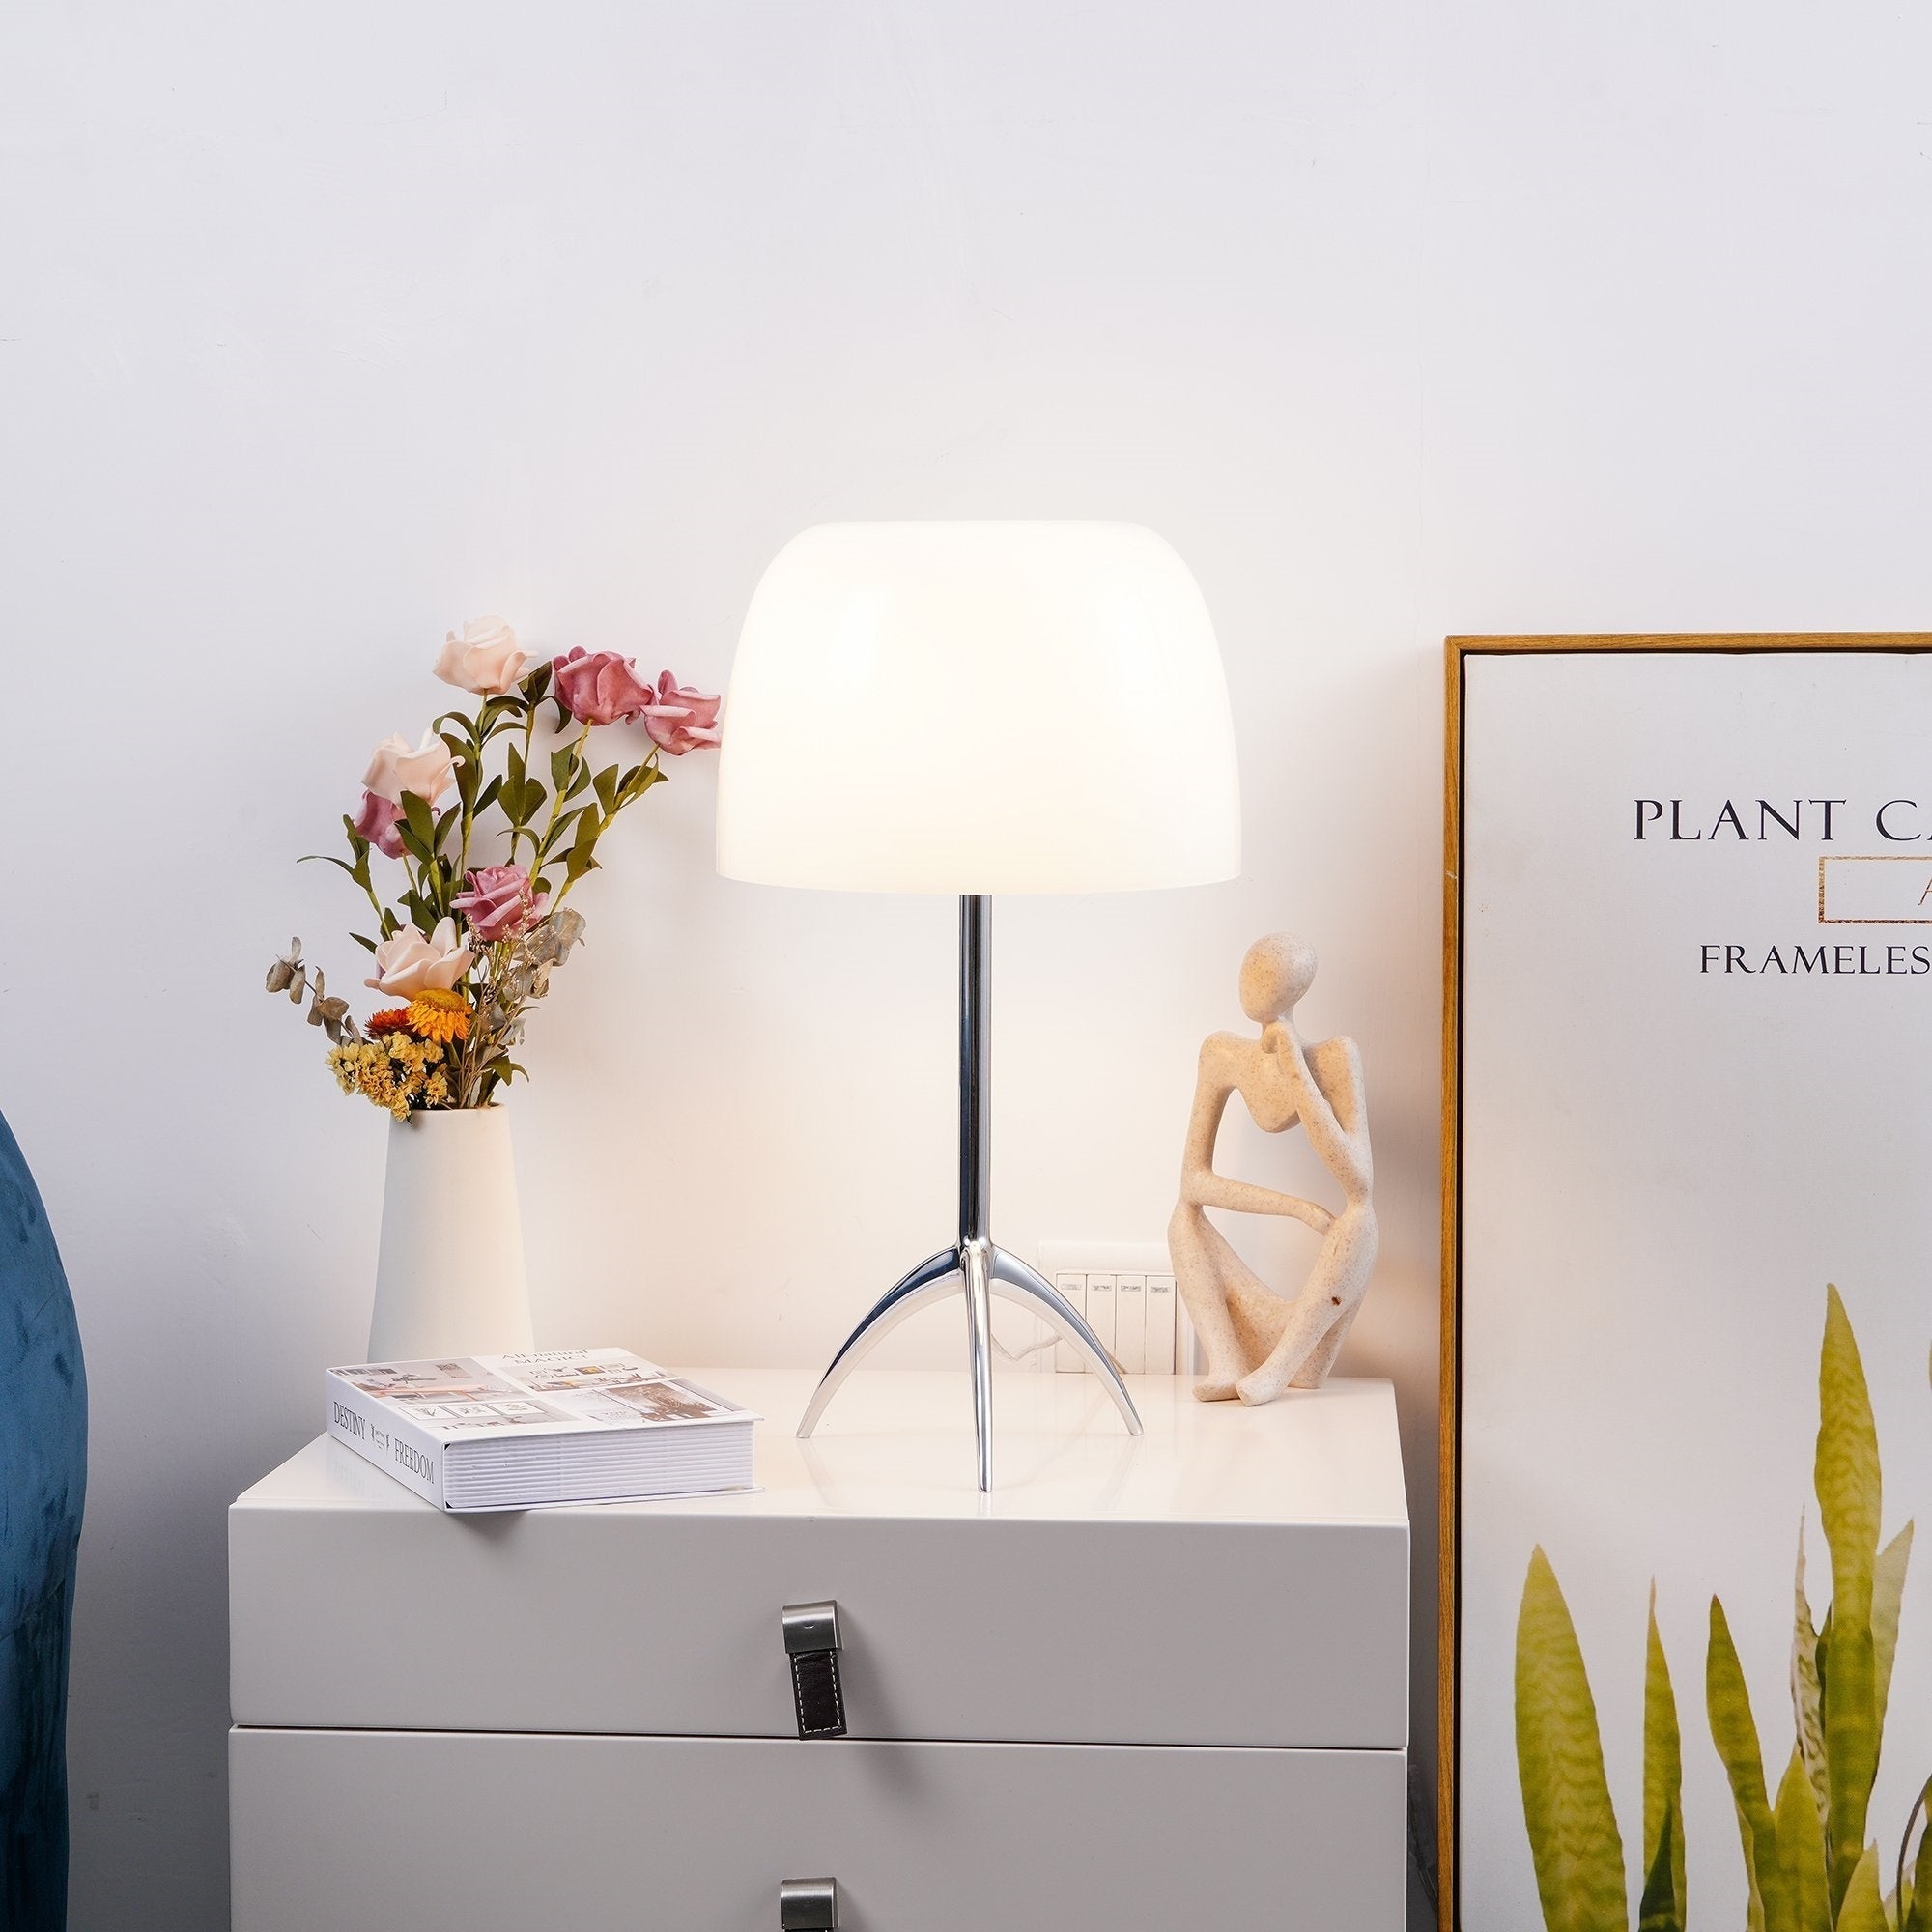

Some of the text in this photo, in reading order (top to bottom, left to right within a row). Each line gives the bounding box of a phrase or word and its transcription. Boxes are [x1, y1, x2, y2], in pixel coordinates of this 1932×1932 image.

[1634, 799, 1932, 841] PLANT C
[1699, 944, 1931, 975] FRAMELES
[333, 1401, 365, 1440] DESTINY
[394, 1438, 434, 1484] FREEDOM
